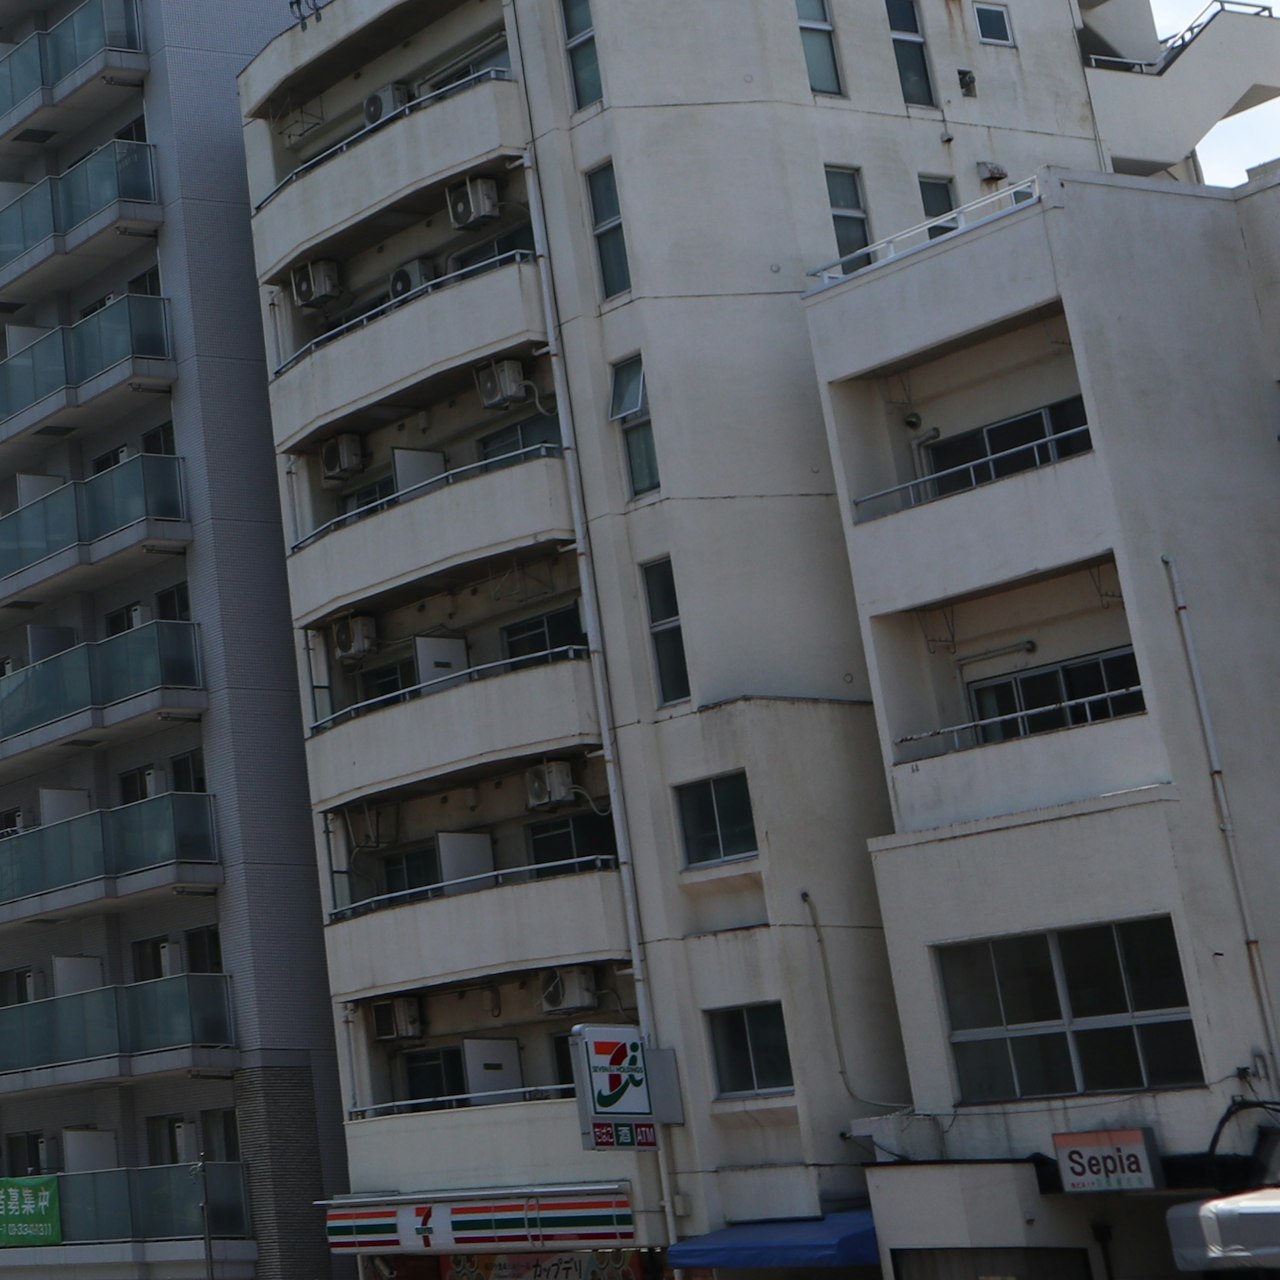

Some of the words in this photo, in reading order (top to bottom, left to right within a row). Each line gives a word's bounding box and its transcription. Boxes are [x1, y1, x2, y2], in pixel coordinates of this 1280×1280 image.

[617, 1126, 631, 1143] 酒
[637, 1127, 656, 1143] ATM
[1068, 1147, 1142, 1178] Sepia
